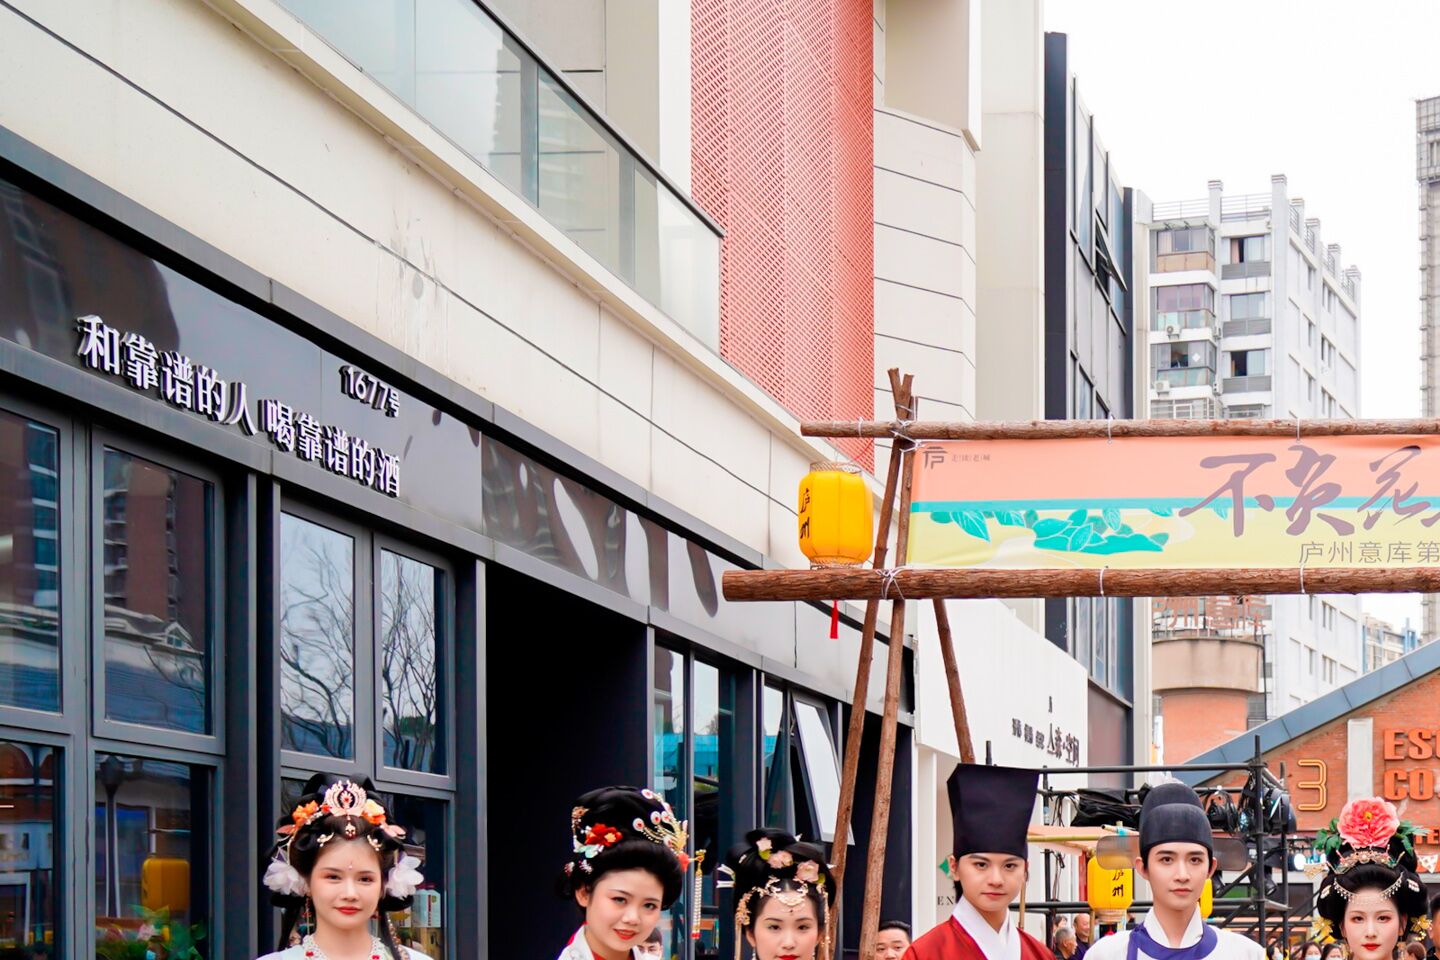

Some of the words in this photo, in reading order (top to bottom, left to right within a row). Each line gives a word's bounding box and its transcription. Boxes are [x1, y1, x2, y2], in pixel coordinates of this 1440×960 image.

[76, 314, 258, 436] 和靠谱的人
[259, 399, 401, 498] 喝靠谱的酒
[339, 364, 401, 418] 1677号
[1297, 759, 1327, 811] 3
